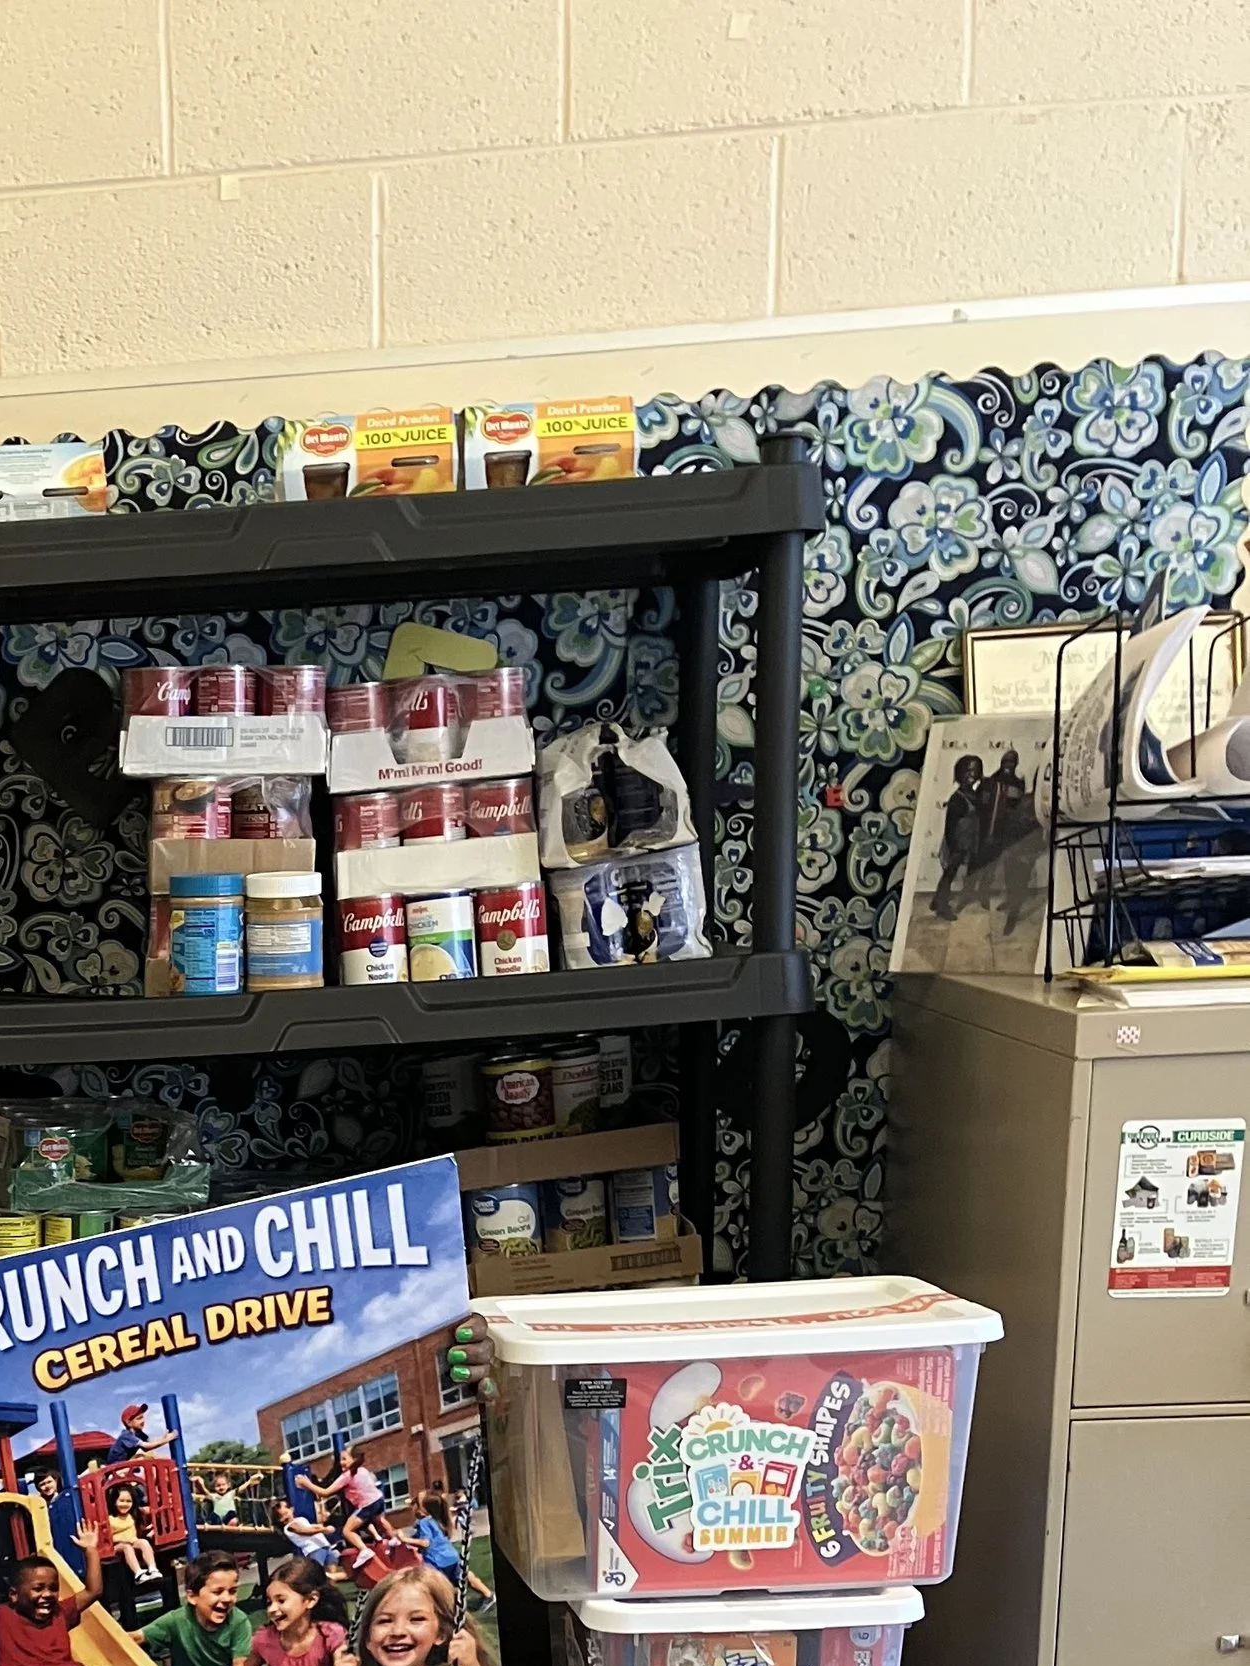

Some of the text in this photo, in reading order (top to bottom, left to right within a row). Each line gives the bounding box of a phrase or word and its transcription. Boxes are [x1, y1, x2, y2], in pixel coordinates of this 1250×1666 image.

[581, 416, 628, 430] JUICE
[399, 427, 447, 442] JUICE
[445, 758, 483, 773] Good!
[365, 963, 395, 973] Chicken
[1177, 1130, 1235, 1142] CURBSIDE
[171, 1226, 246, 1285] AND
[253, 1182, 429, 1279] CHILL
[479, 1223, 531, 1237] Green Beans
[34, 1287, 333, 1391] CEREAL DRIVE
[686, 1429, 810, 1461] CRUNCH
[738, 1454, 755, 1471] &
[806, 1381, 852, 1559] 6 FRUITY SHAPES
[635, 1425, 694, 1532] Trix
[697, 1499, 794, 1527] CHILL
[700, 1526, 789, 1545] SUMMER
